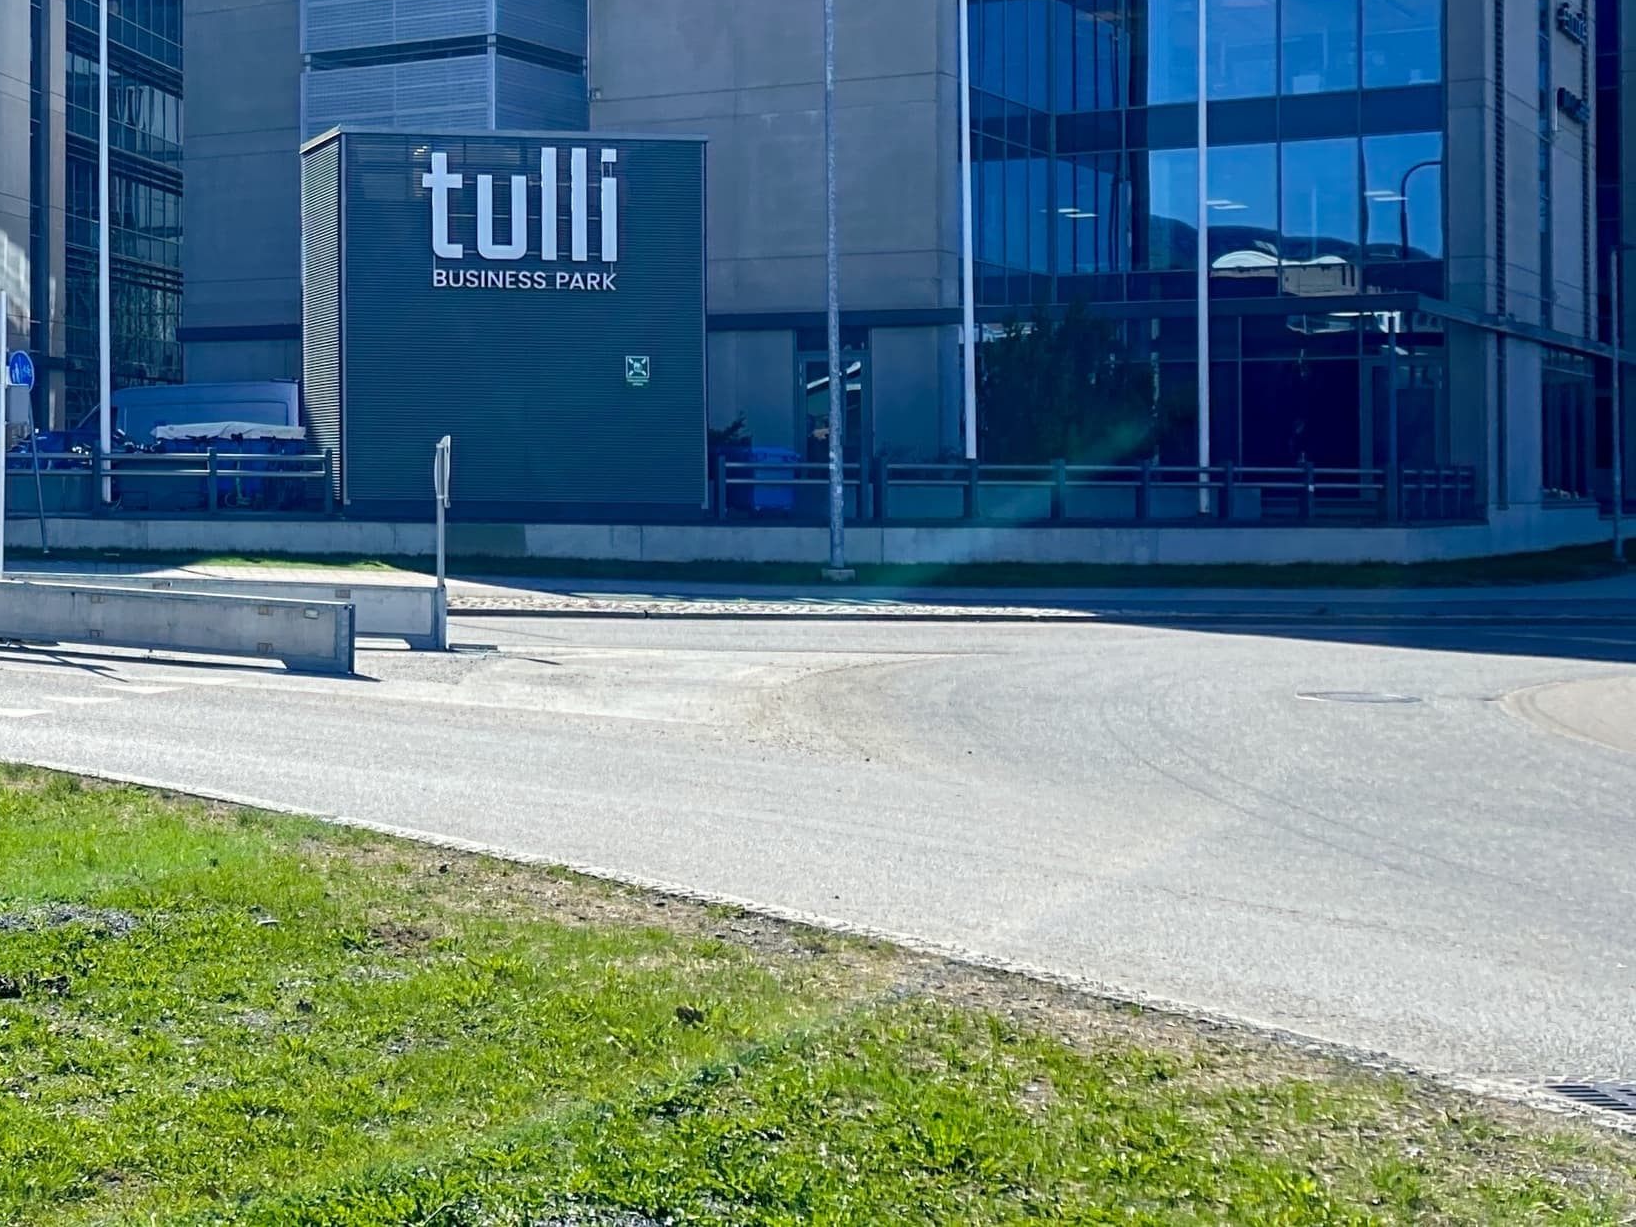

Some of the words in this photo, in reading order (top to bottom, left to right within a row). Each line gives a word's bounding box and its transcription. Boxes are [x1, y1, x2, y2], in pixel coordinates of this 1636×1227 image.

[422, 147, 618, 262] tulli
[433, 269, 546, 290] BUSINESS
[556, 272, 616, 291] PARK
